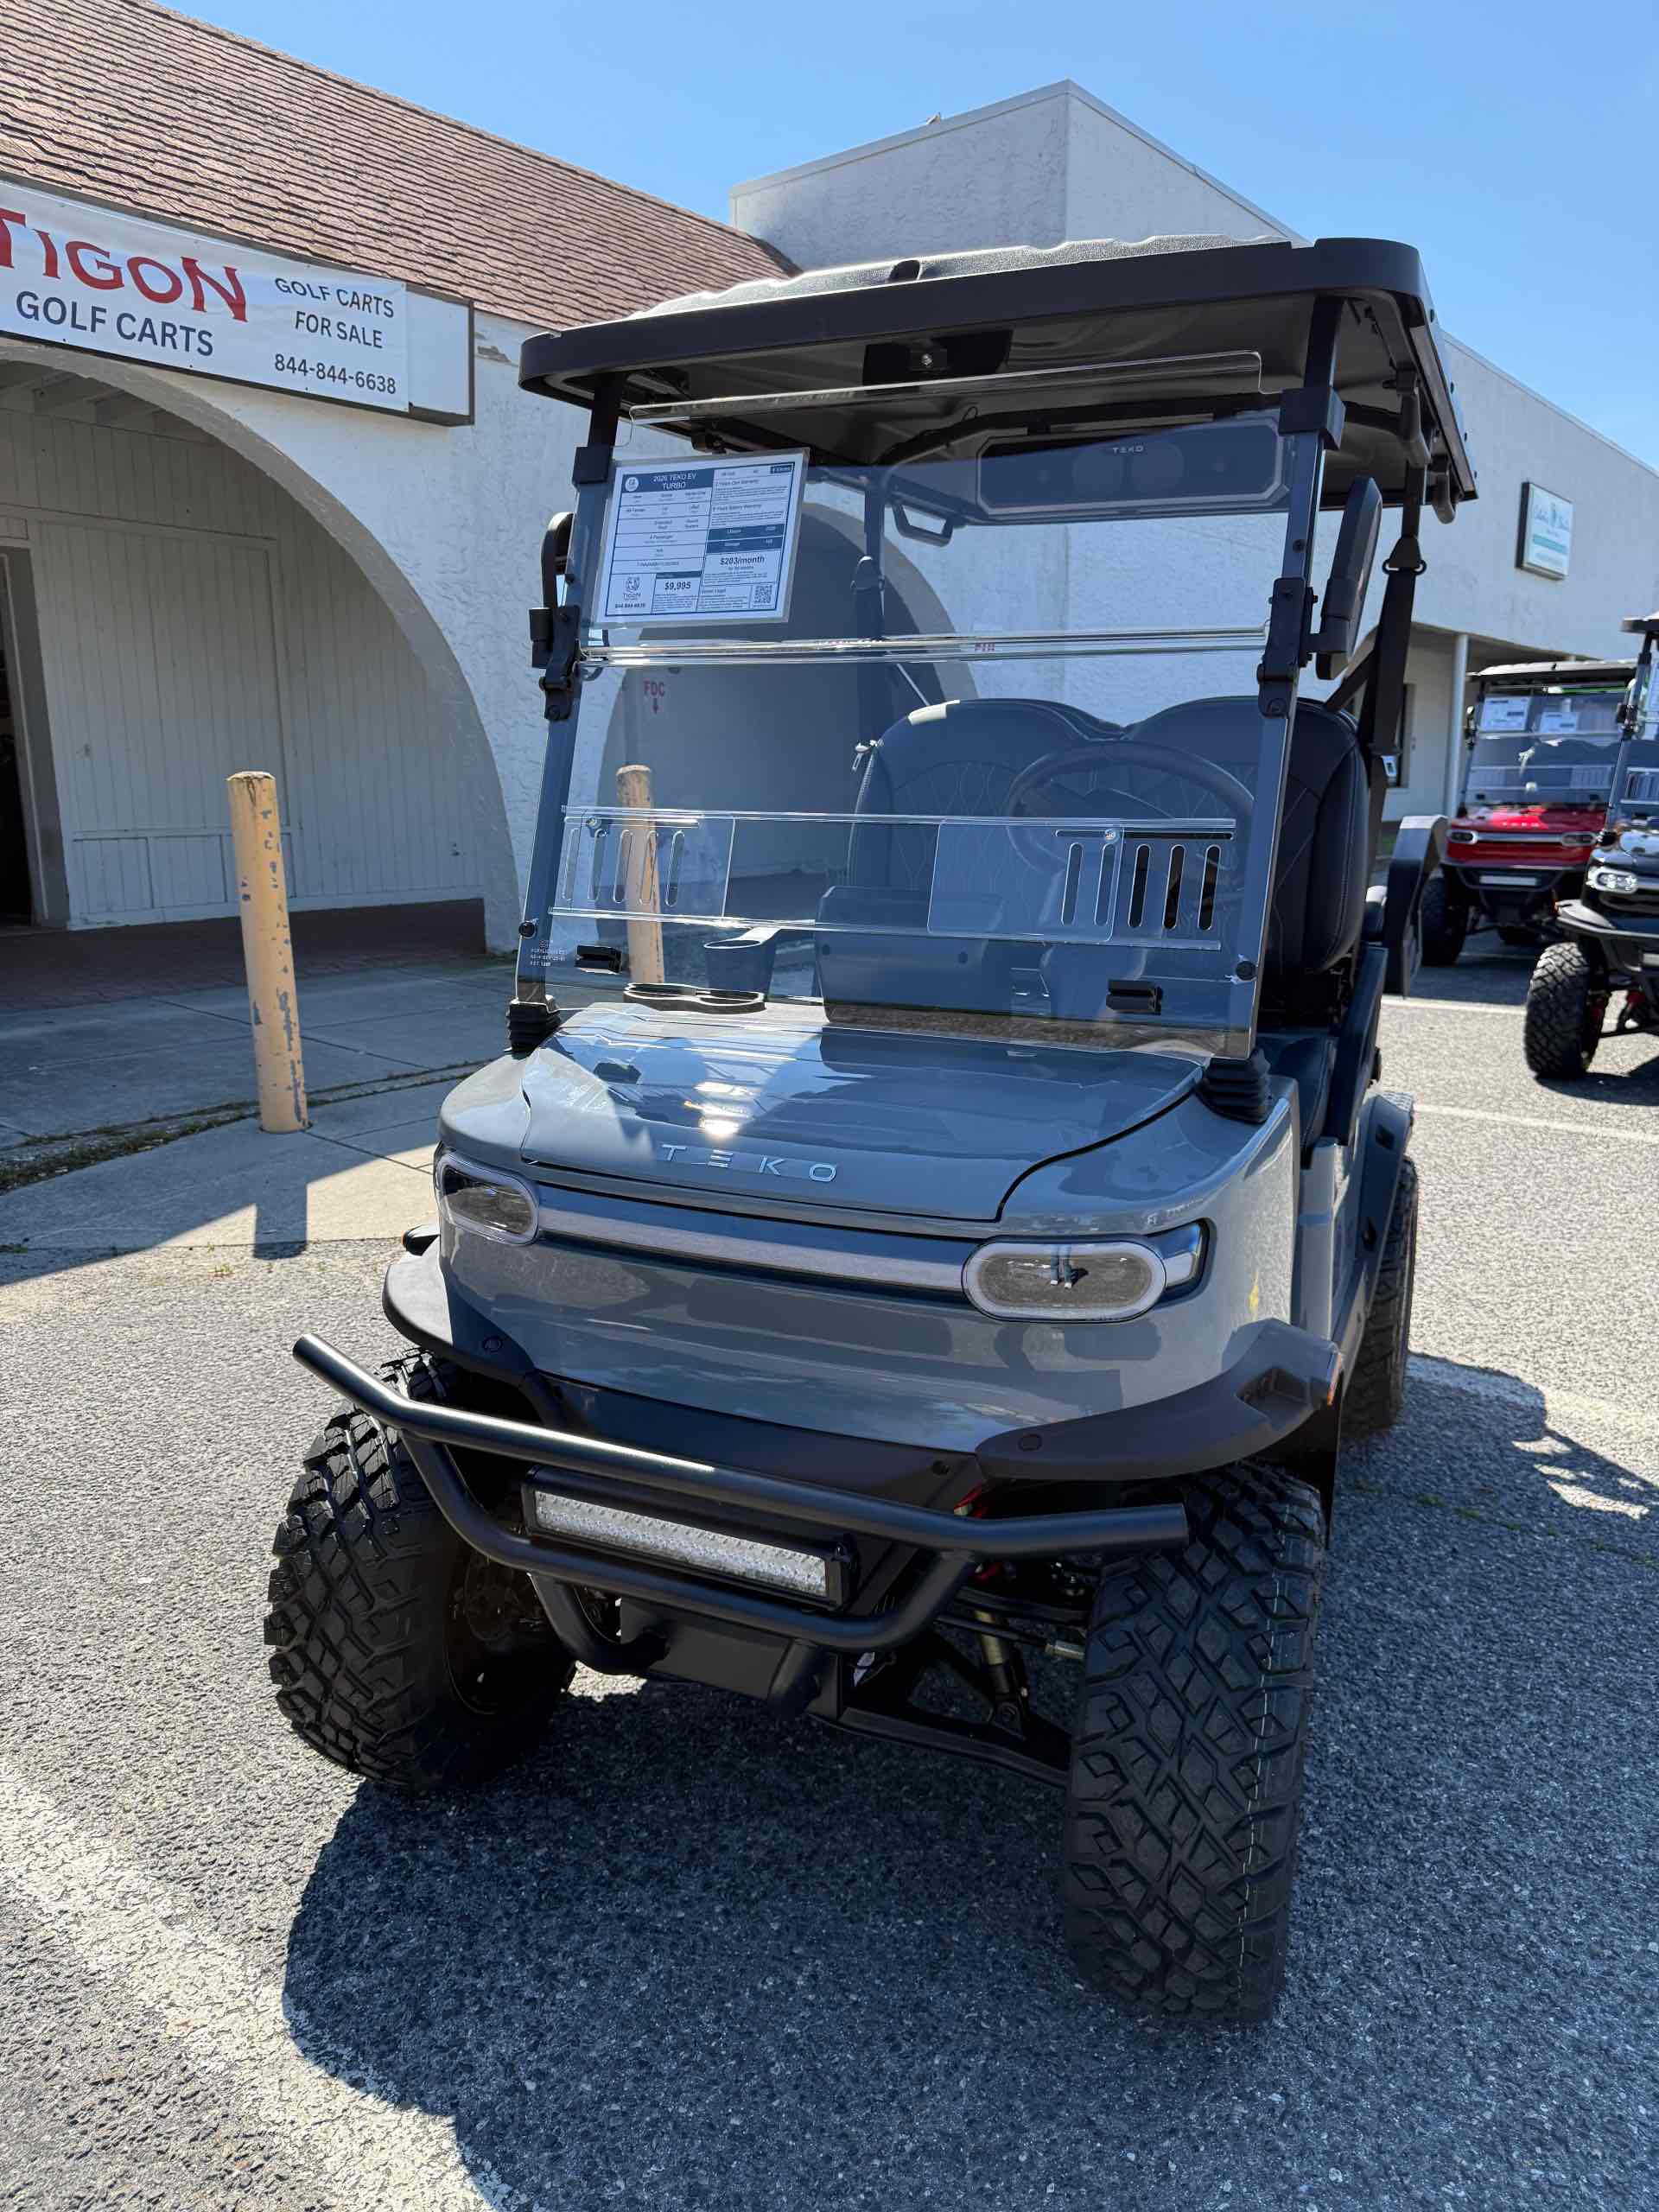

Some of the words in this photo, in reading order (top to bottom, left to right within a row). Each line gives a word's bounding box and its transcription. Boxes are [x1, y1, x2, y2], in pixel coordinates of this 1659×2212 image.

[275, 277, 330, 302] GOLF
[336, 289, 394, 318] CARTS
[16, 290, 107, 333] GOLF
[116, 312, 214, 356] CARTS
[295, 310, 332, 338] FOR
[337, 321, 383, 348] SALE
[274, 353, 397, 394] 844-844-6638
[663, 481, 686, 490] TURBO
[720, 555, 766, 566] $203/month
[664, 581, 691, 591] $9,995
[661, 1143, 837, 1183] TEKO
